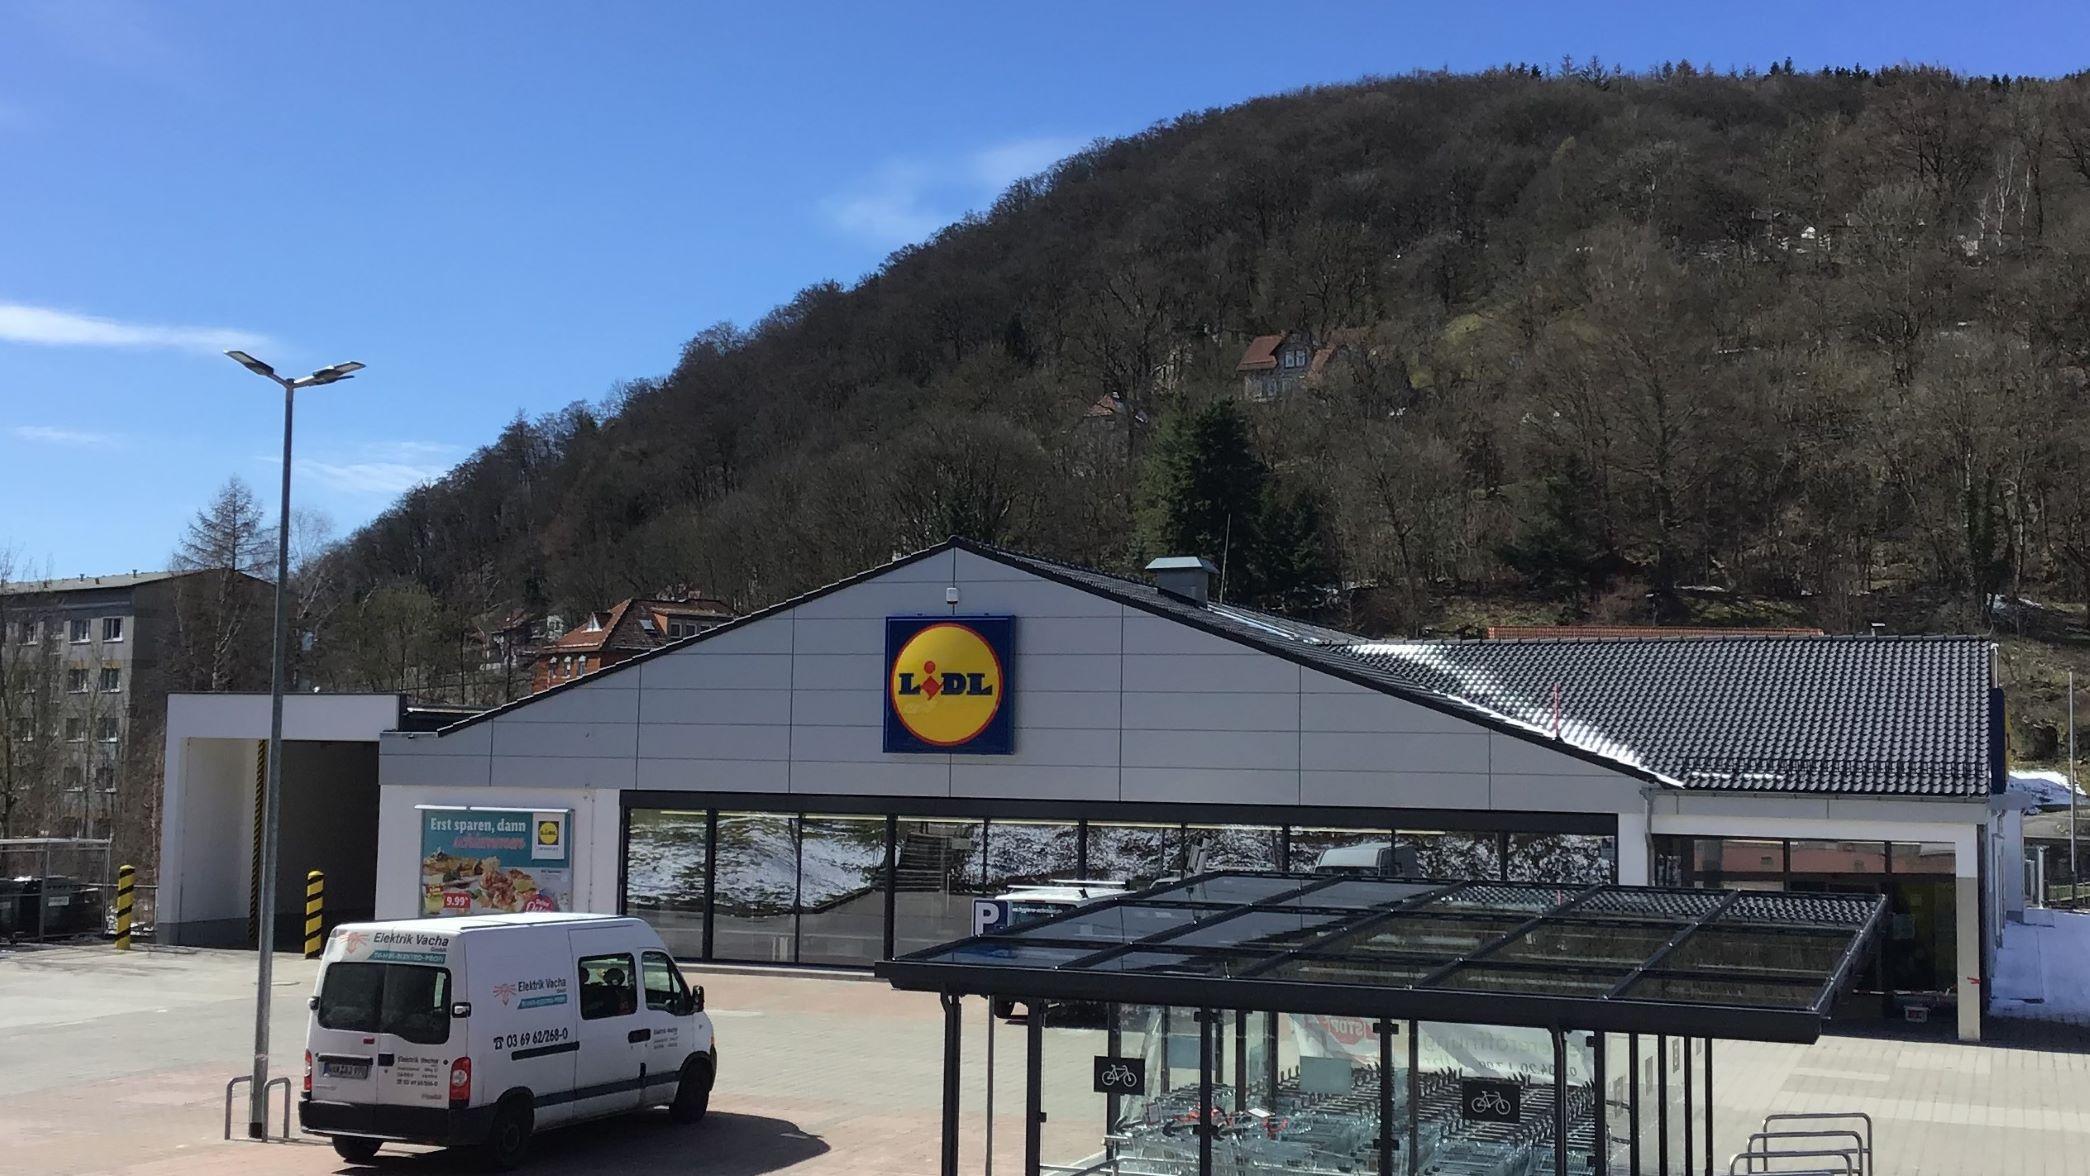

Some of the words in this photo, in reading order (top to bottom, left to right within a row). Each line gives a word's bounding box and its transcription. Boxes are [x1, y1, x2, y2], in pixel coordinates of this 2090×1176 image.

[430, 818, 451, 830] Erst
[454, 819, 495, 834] sparen,
[497, 818, 526, 832] dann
[974, 902, 1000, 936] P
[373, 932, 413, 945] Elektrik
[416, 934, 449, 947] Vacha
[518, 978, 544, 992] Elektrik
[546, 977, 567, 989] Vacha
[506, 1034, 518, 1049] 03
[520, 1032, 531, 1046] 69
[532, 1028, 568, 1044] 62/268-0
